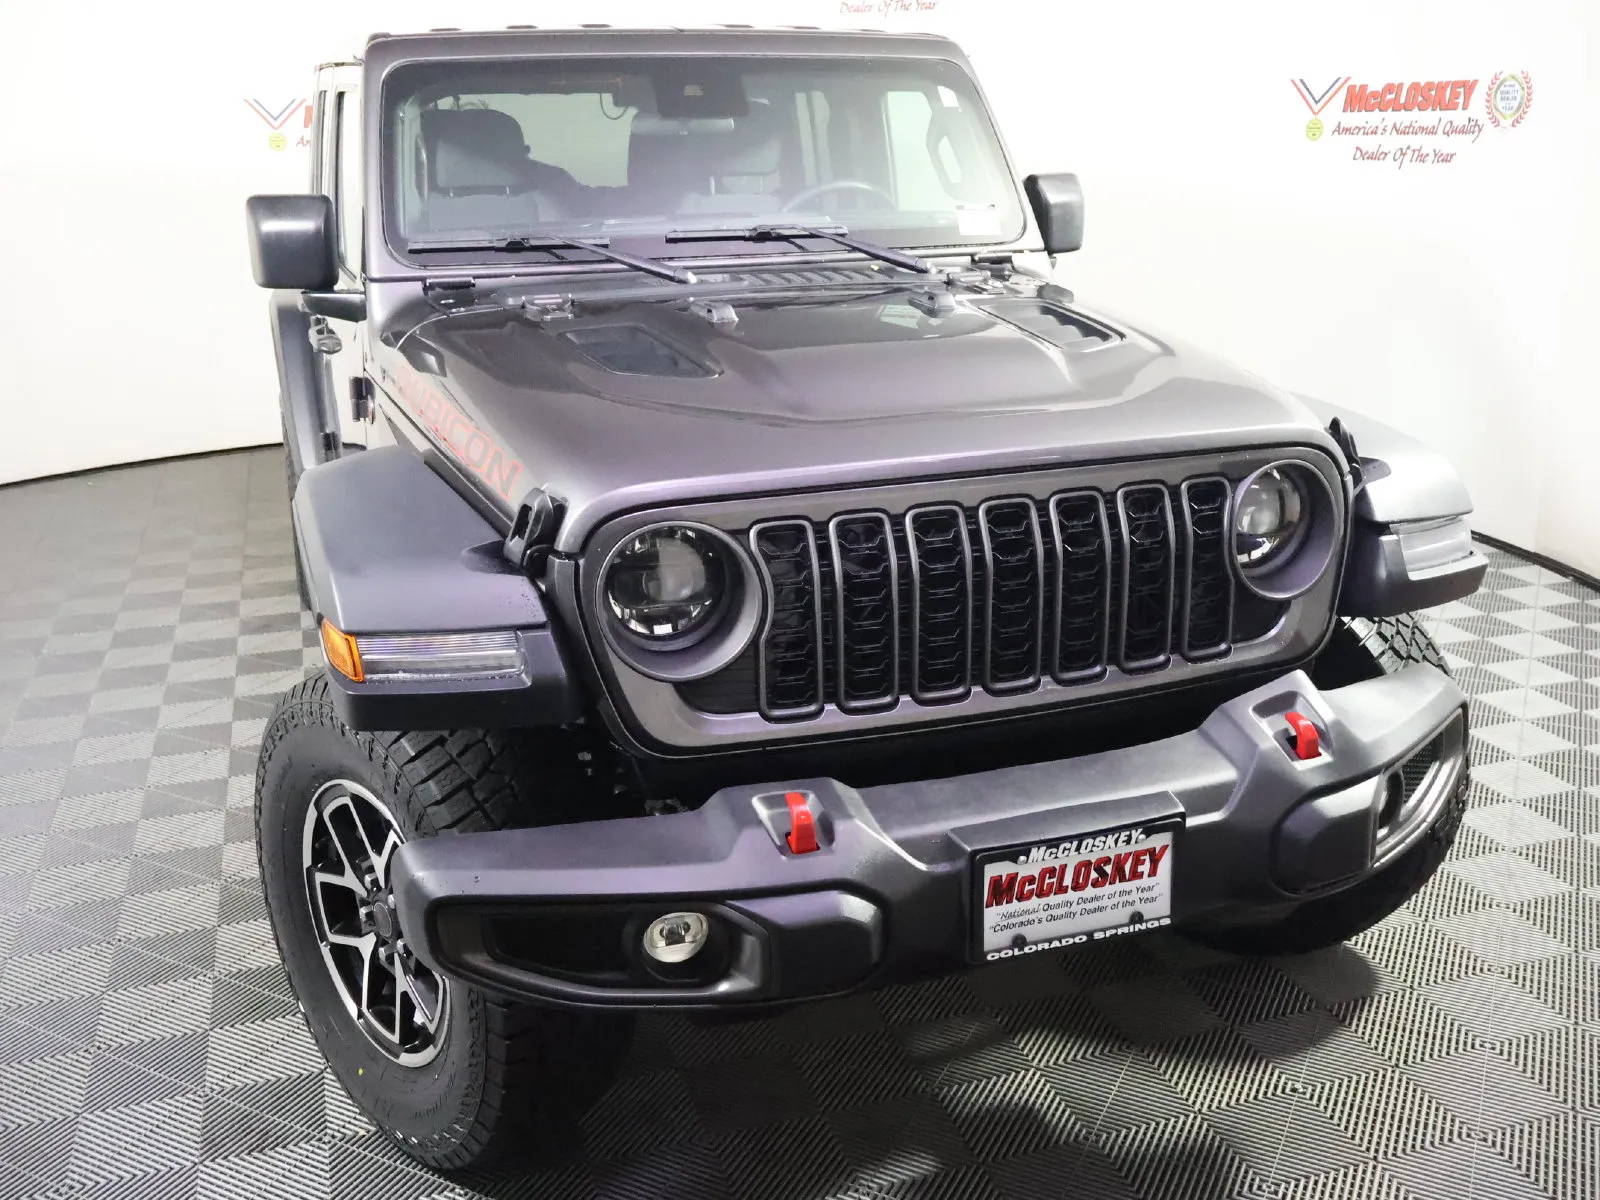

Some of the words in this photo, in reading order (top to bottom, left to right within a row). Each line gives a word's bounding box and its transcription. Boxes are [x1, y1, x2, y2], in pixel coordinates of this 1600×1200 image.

[1343, 79, 1479, 113] McCLOSKEY
[1331, 118, 1387, 137] America's
[1389, 117, 1441, 136] National
[1442, 117, 1484, 143] Quality
[1352, 144, 1390, 162] Dealer
[1393, 145, 1410, 170] Of
[1409, 146, 1430, 164] The
[1431, 149, 1456, 164] Year
[396, 362, 524, 500] UBICON
[1027, 829, 1143, 864] McCLOSKEY
[985, 844, 1170, 908] McCLOSKEY
[1042, 899, 1075, 913] Quality
[1076, 894, 1106, 906] Dealer
[1107, 891, 1117, 900] of
[1119, 888, 1133, 898] the
[1045, 910, 1078, 924] Quality
[1079, 904, 1109, 917] Dealer
[1110, 901, 1120, 911] of
[1121, 898, 1136, 909] the
[986, 934, 1088, 961] COLORADO
[1092, 917, 1172, 941] SPRINGS
